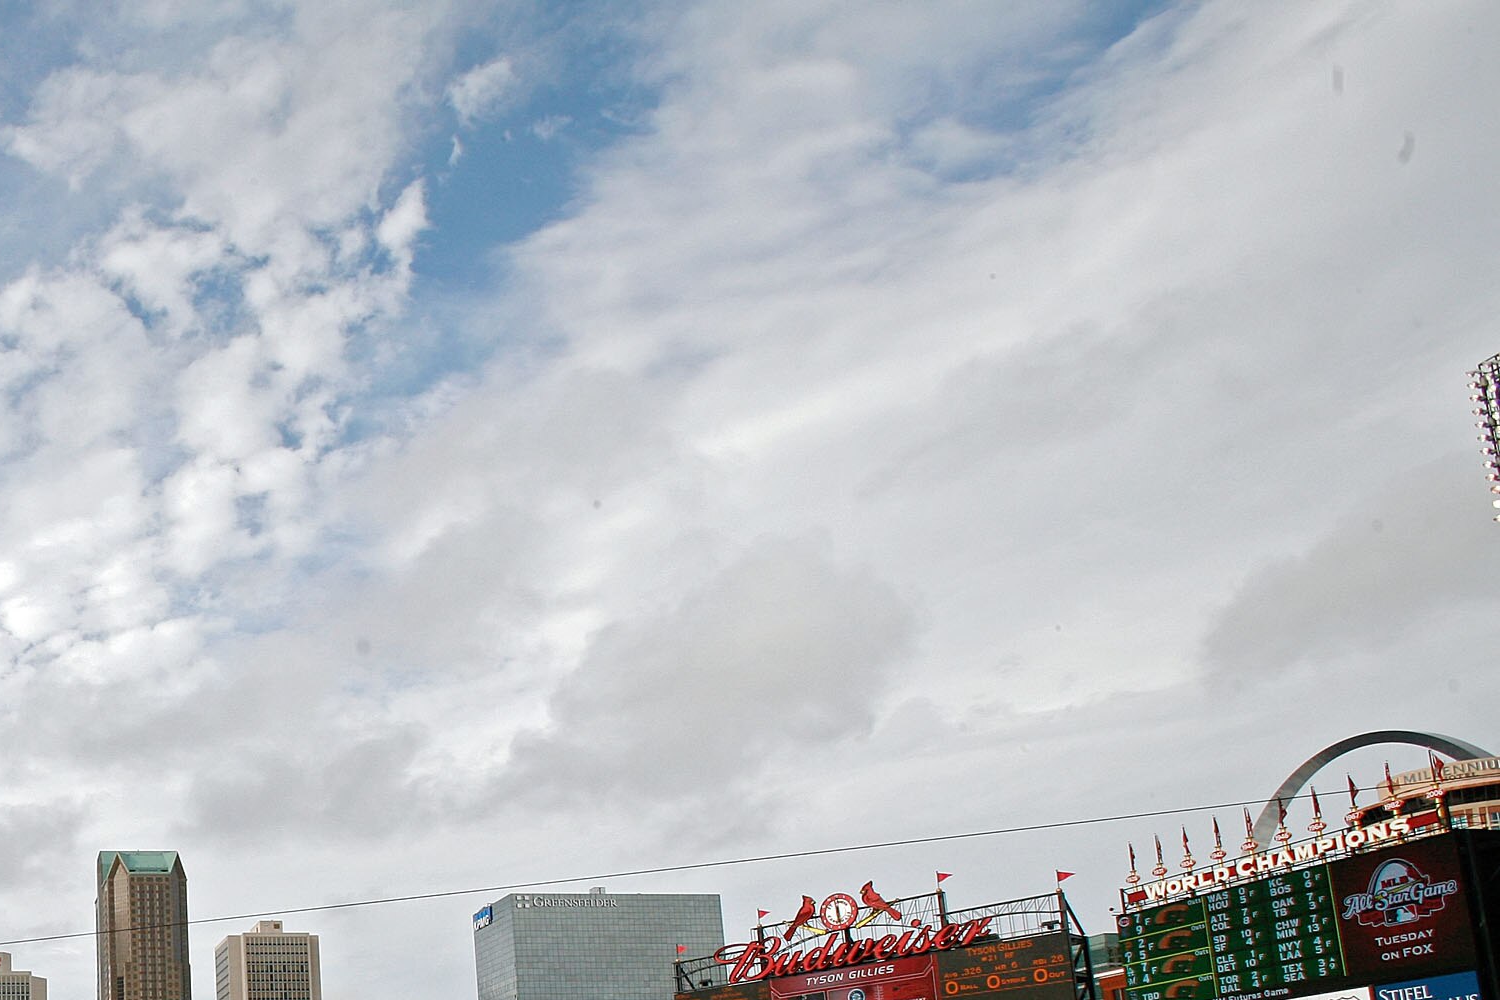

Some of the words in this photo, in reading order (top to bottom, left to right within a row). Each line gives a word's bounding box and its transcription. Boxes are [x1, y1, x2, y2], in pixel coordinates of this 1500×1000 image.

[1426, 789, 1443, 799] 2006
[1384, 800, 1401, 812] 1982
[1144, 866, 1230, 901] WORLD
[1236, 818, 1410, 877] CHAMPIONS
[1268, 878, 1284, 888] KC
[1269, 885, 1292, 897] BOS
[1207, 891, 1229, 903] WAS
[1342, 892, 1373, 919] All
[1375, 889, 1411, 910] Star
[1410, 880, 1458, 904] Game
[1208, 901, 1229, 912] HOU
[1272, 897, 1295, 909] OAK
[1211, 913, 1229, 924] ATL
[1273, 908, 1289, 918] TB
[474, 915, 491, 931] KPMG
[1211, 922, 1230, 932] COL
[1275, 918, 1299, 931] CHW
[1213, 934, 1226, 944] SD
[1276, 928, 1297, 939] MIN
[1375, 929, 1434, 946] TUESDAY
[713, 917, 993, 984] Budweiser
[1214, 943, 1227, 953] SF
[1278, 940, 1301, 952] NYY
[1279, 951, 1302, 961] LAA
[1381, 951, 1400, 961] ON
[1402, 943, 1434, 957] FOX
[1216, 954, 1235, 965] CLE
[1217, 962, 1236, 973] DET
[1282, 963, 1303, 974] TEX
[806, 974, 843, 986] TYSON
[848, 964, 894, 980] GILLIES
[1219, 975, 1239, 985] TOR
[1283, 973, 1305, 983] SEA
[1220, 984, 1241, 994] BAL
[1263, 987, 1290, 998] Game
